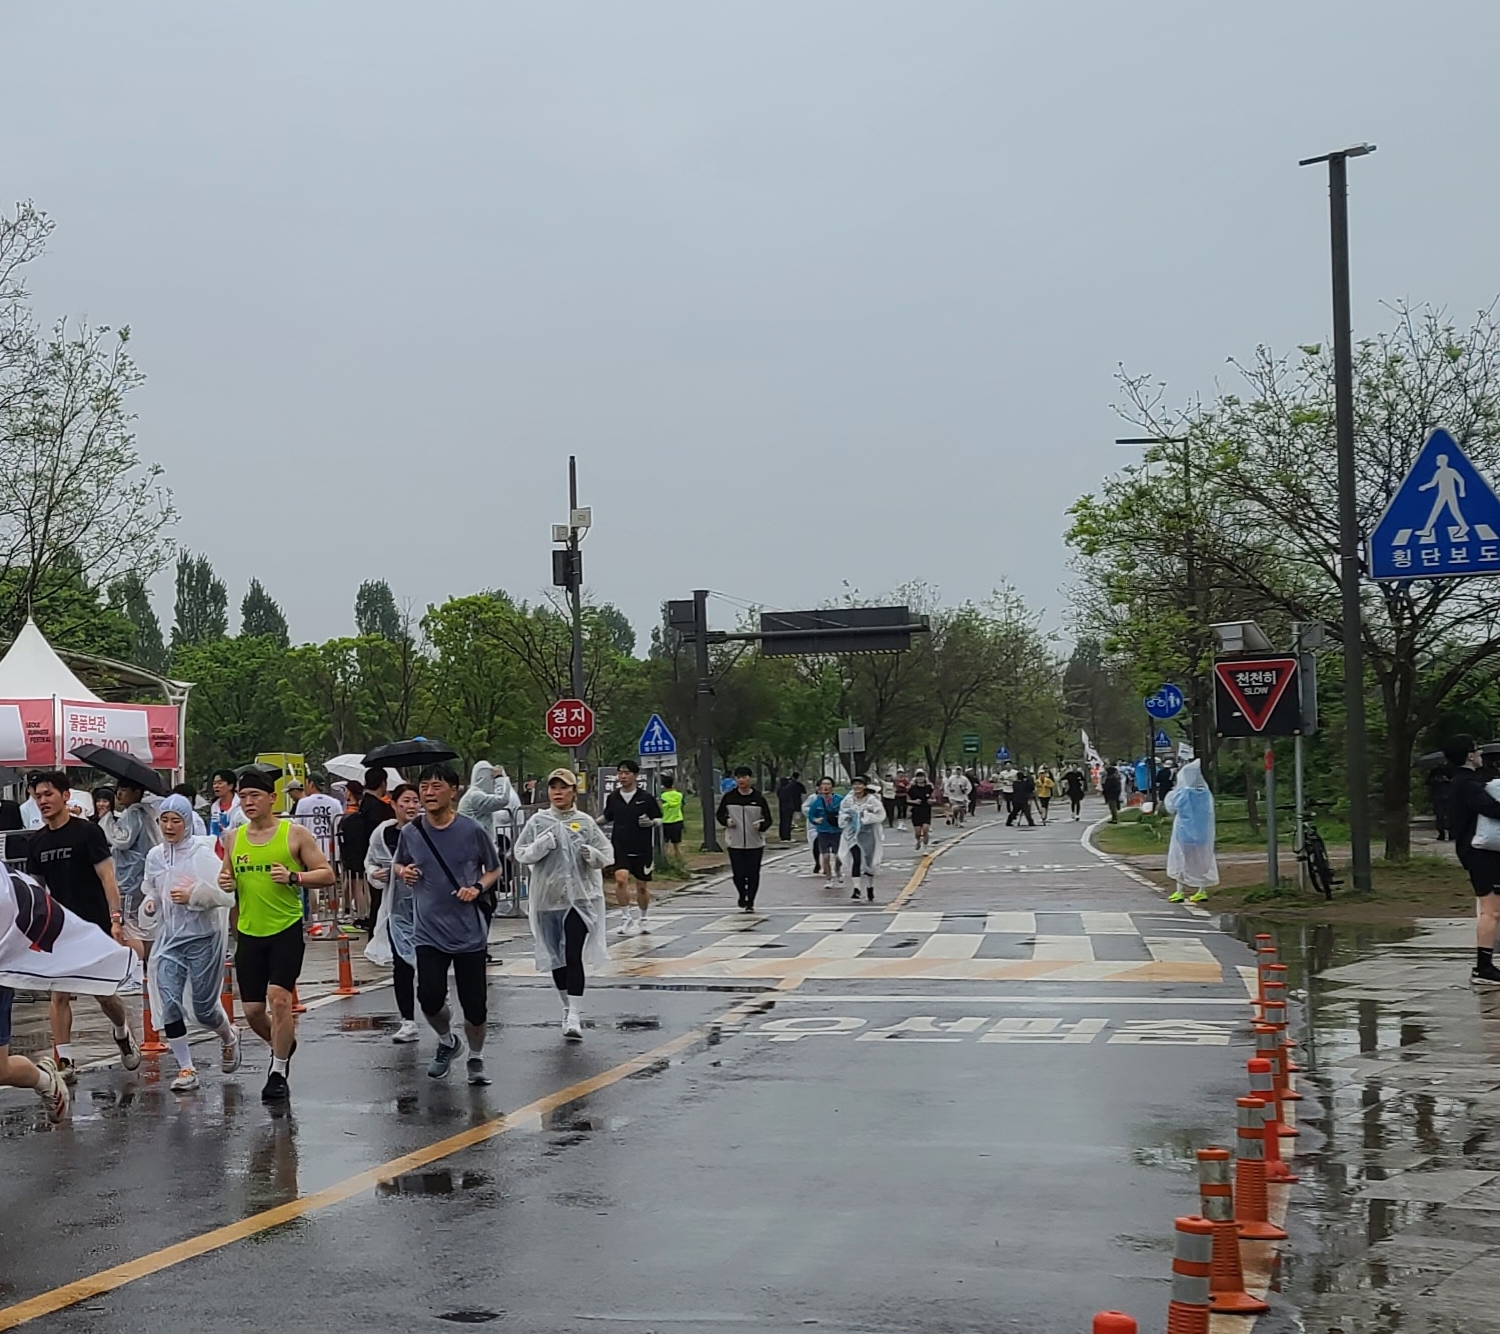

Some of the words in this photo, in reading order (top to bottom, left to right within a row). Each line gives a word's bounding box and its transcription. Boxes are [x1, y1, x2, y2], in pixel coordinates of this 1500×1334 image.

[1391, 546, 1500, 568] 횡단보도
[1235, 670, 1276, 687] 천천히
[1244, 687, 1269, 696] SLOW
[553, 707, 586, 723] 정지
[69, 714, 106, 733] 물품보관
[553, 726, 586, 738] STOP
